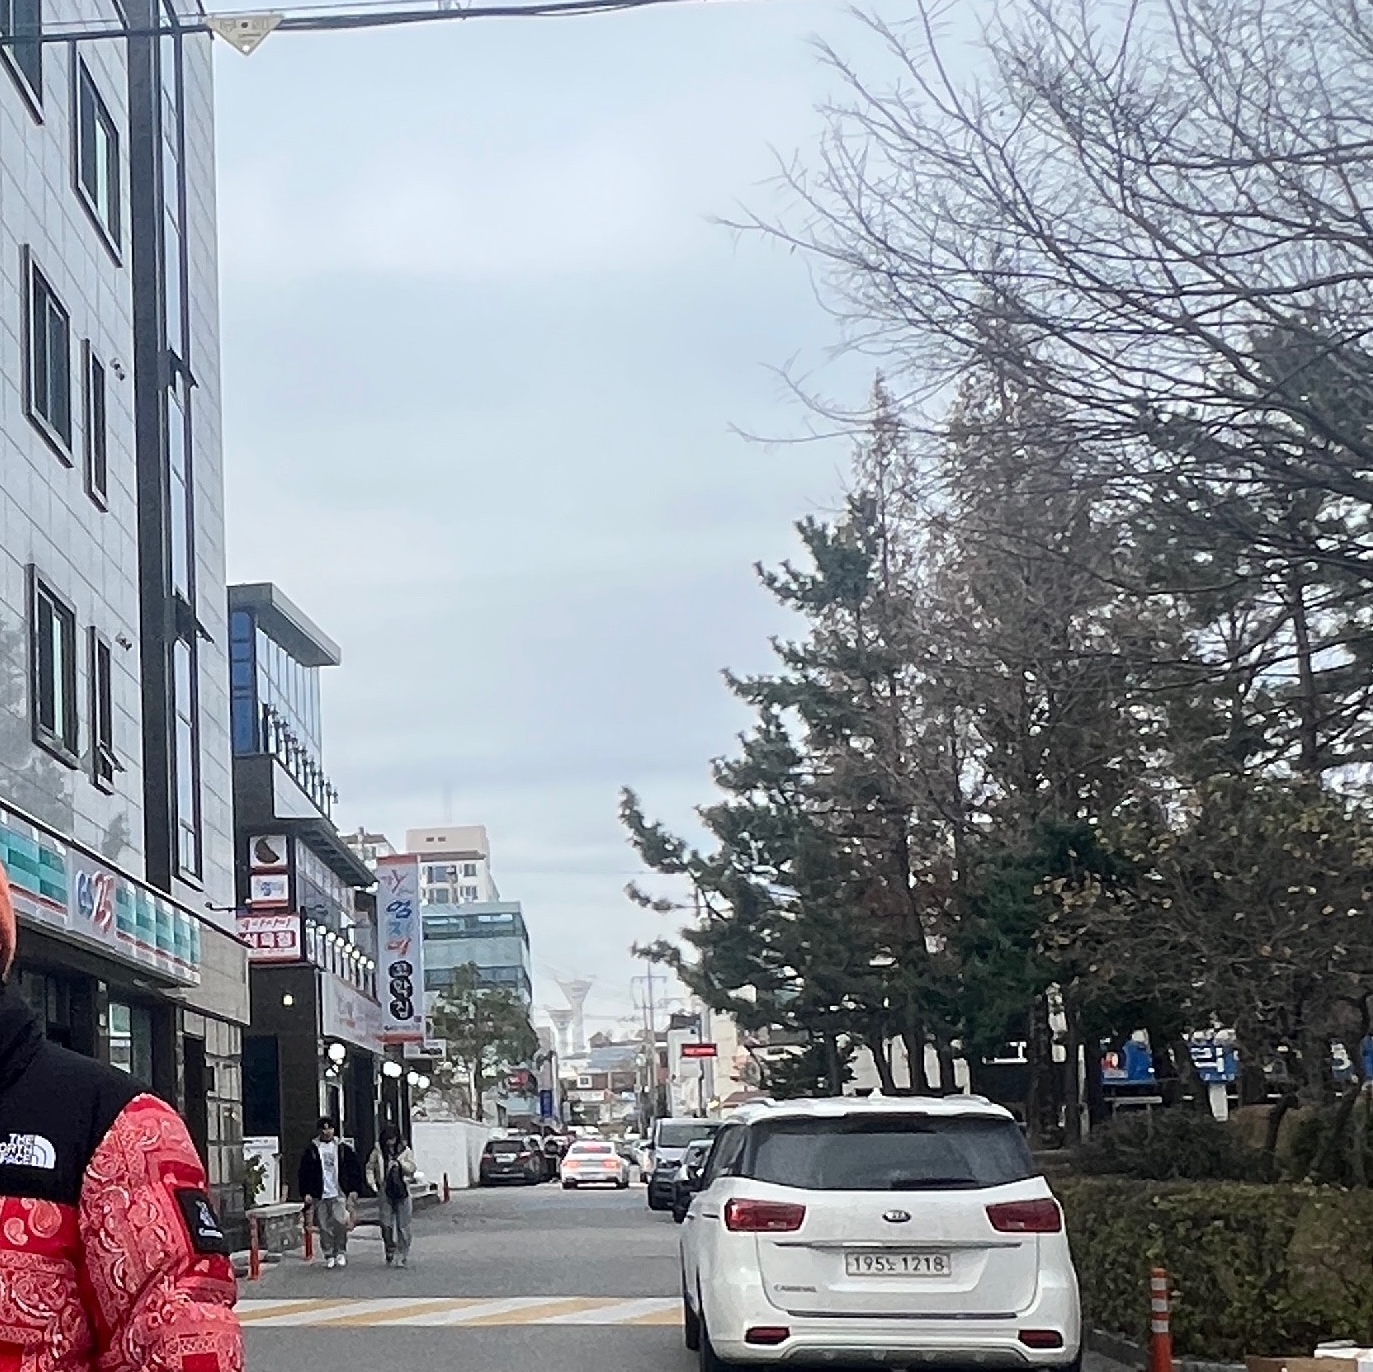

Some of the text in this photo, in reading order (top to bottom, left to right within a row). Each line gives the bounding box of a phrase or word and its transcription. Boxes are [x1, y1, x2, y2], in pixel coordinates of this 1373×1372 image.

[9, 1134, 35, 1145] THE
[0, 1153, 32, 1165] FACE
[901, 1256, 945, 1272] 1218
